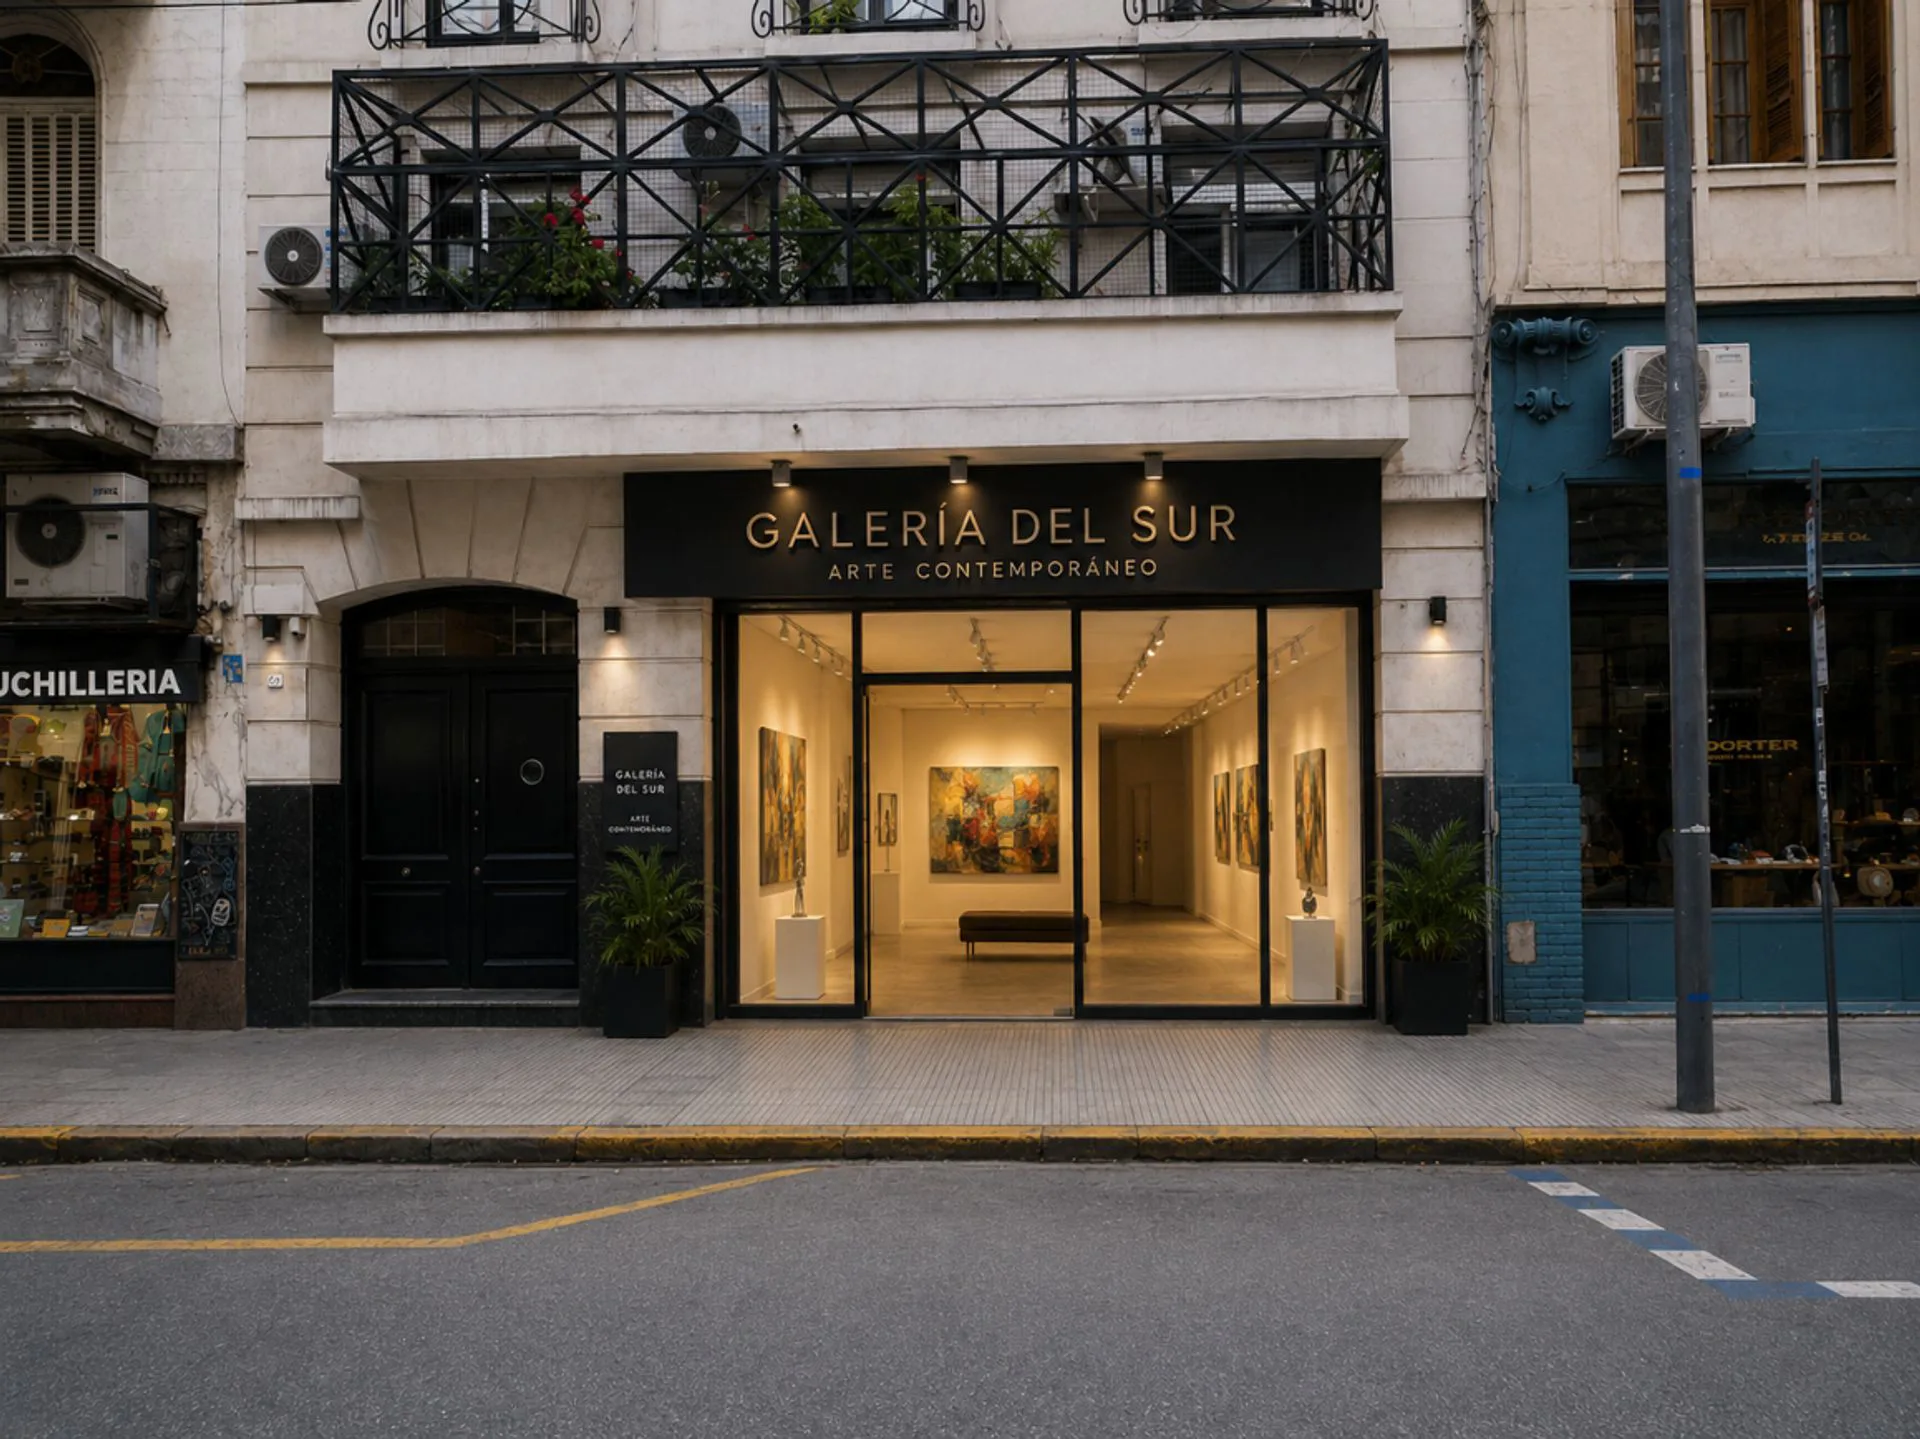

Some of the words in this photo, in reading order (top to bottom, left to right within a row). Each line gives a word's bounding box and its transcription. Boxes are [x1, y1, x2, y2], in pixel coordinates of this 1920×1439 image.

[746, 502, 986, 548] GALERÍA
[1012, 508, 1106, 545] DEL
[1132, 505, 1236, 542] SUR
[828, 563, 894, 580] ARTE
[916, 556, 1157, 579] CONTEMPORÁNEO
[615, 768, 665, 780] GALERÍA
[616, 784, 638, 794] DEL
[642, 784, 665, 794] SUR
